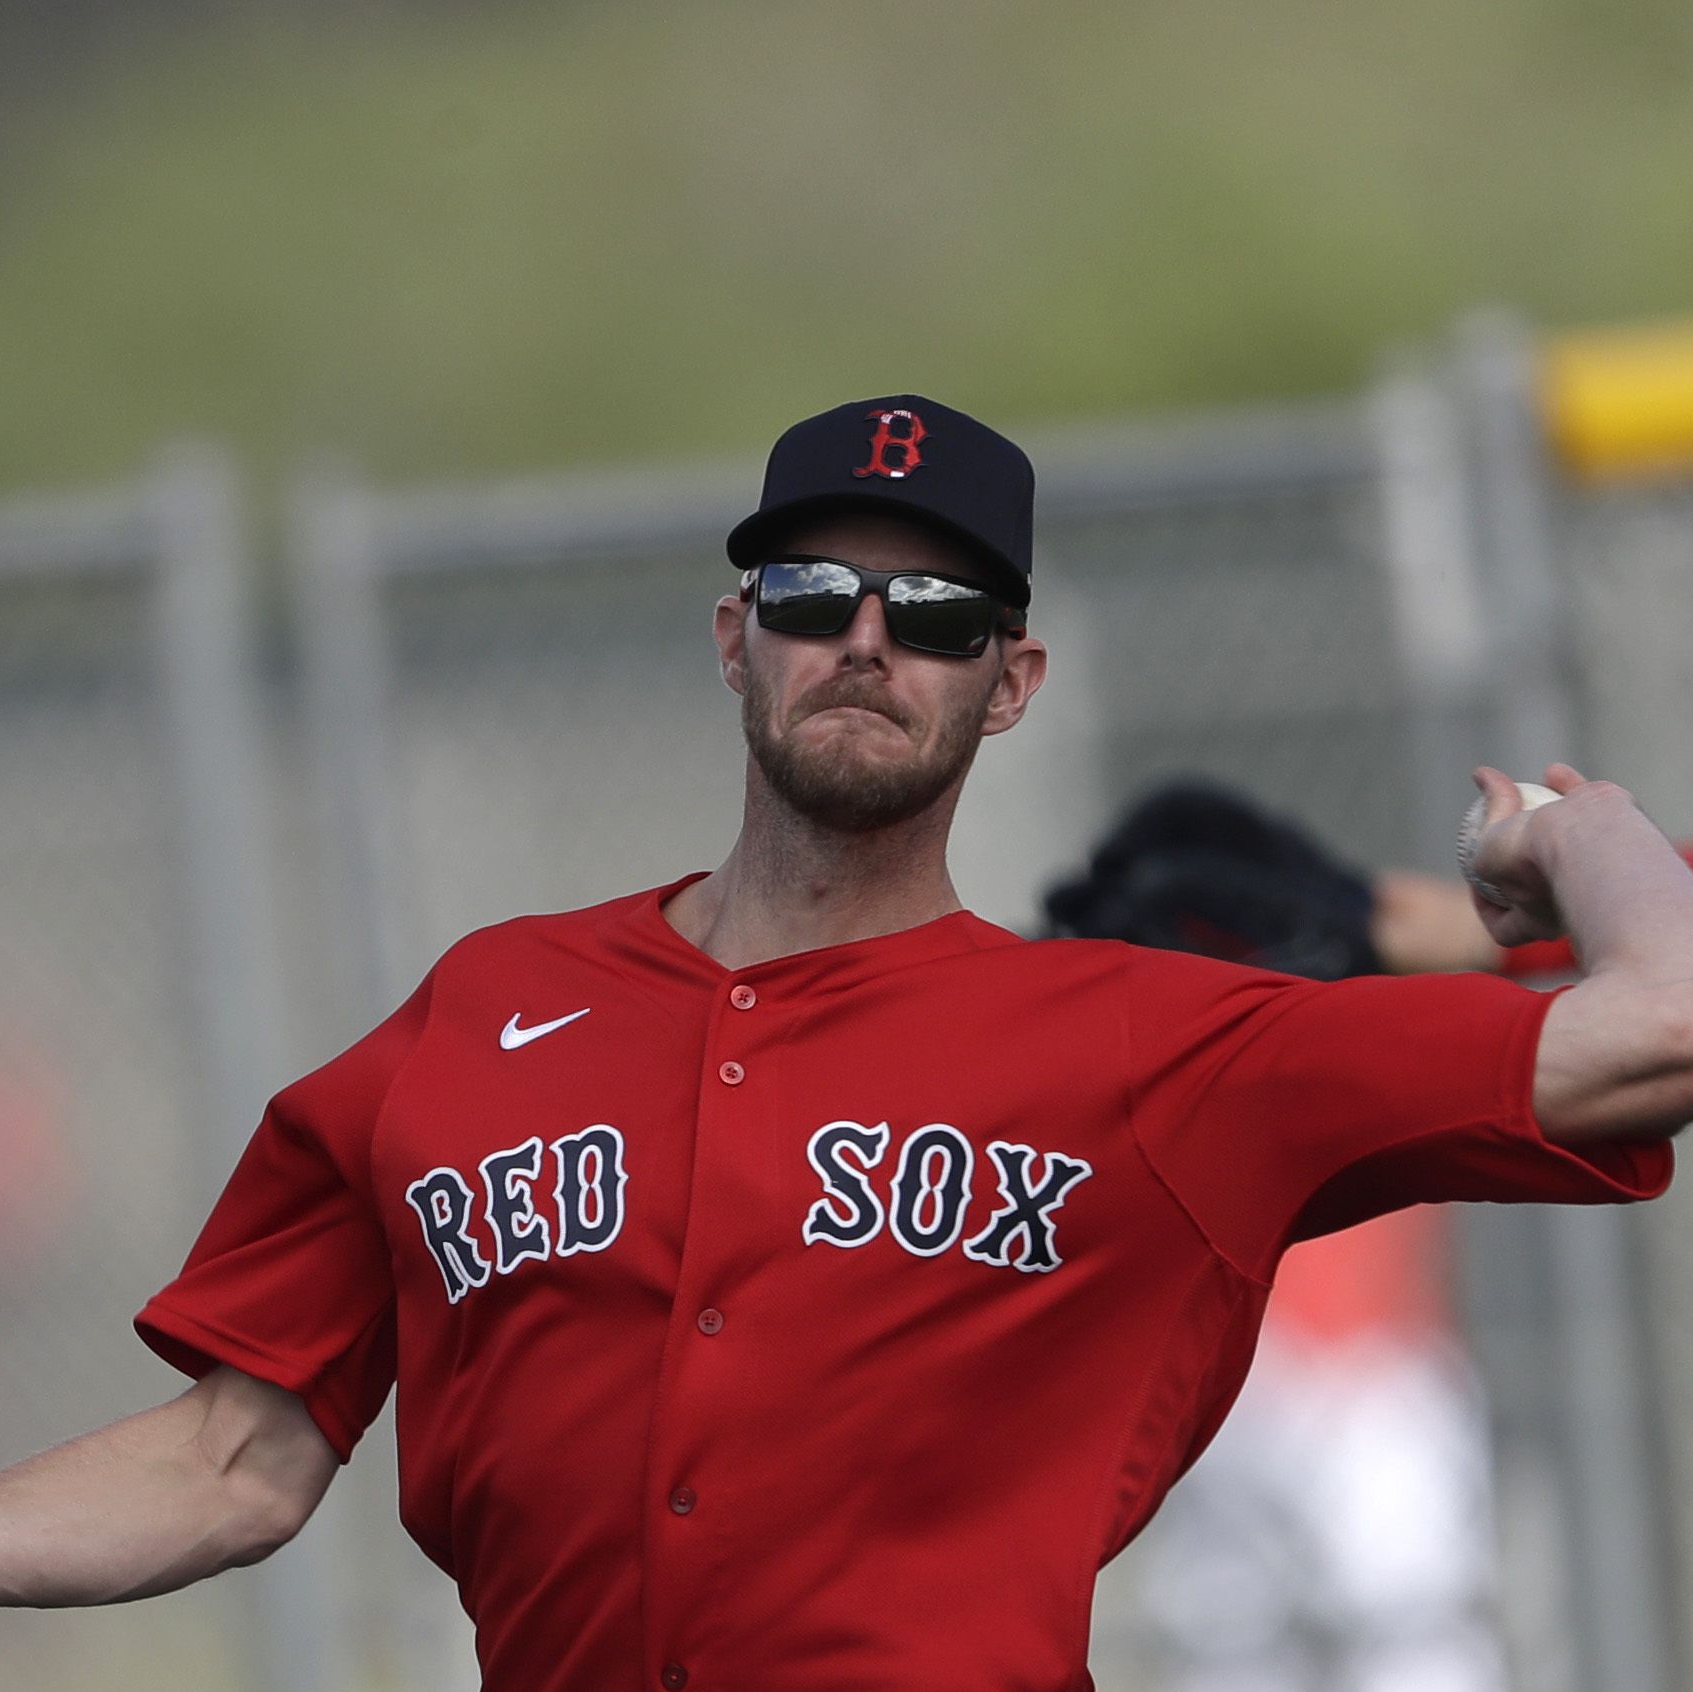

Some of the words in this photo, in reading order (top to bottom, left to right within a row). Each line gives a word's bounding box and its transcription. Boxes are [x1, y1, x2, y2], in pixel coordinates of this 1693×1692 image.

[853, 409, 931, 479] B
[405, 1123, 629, 1304] RED
[802, 1120, 1093, 1274] SOX
